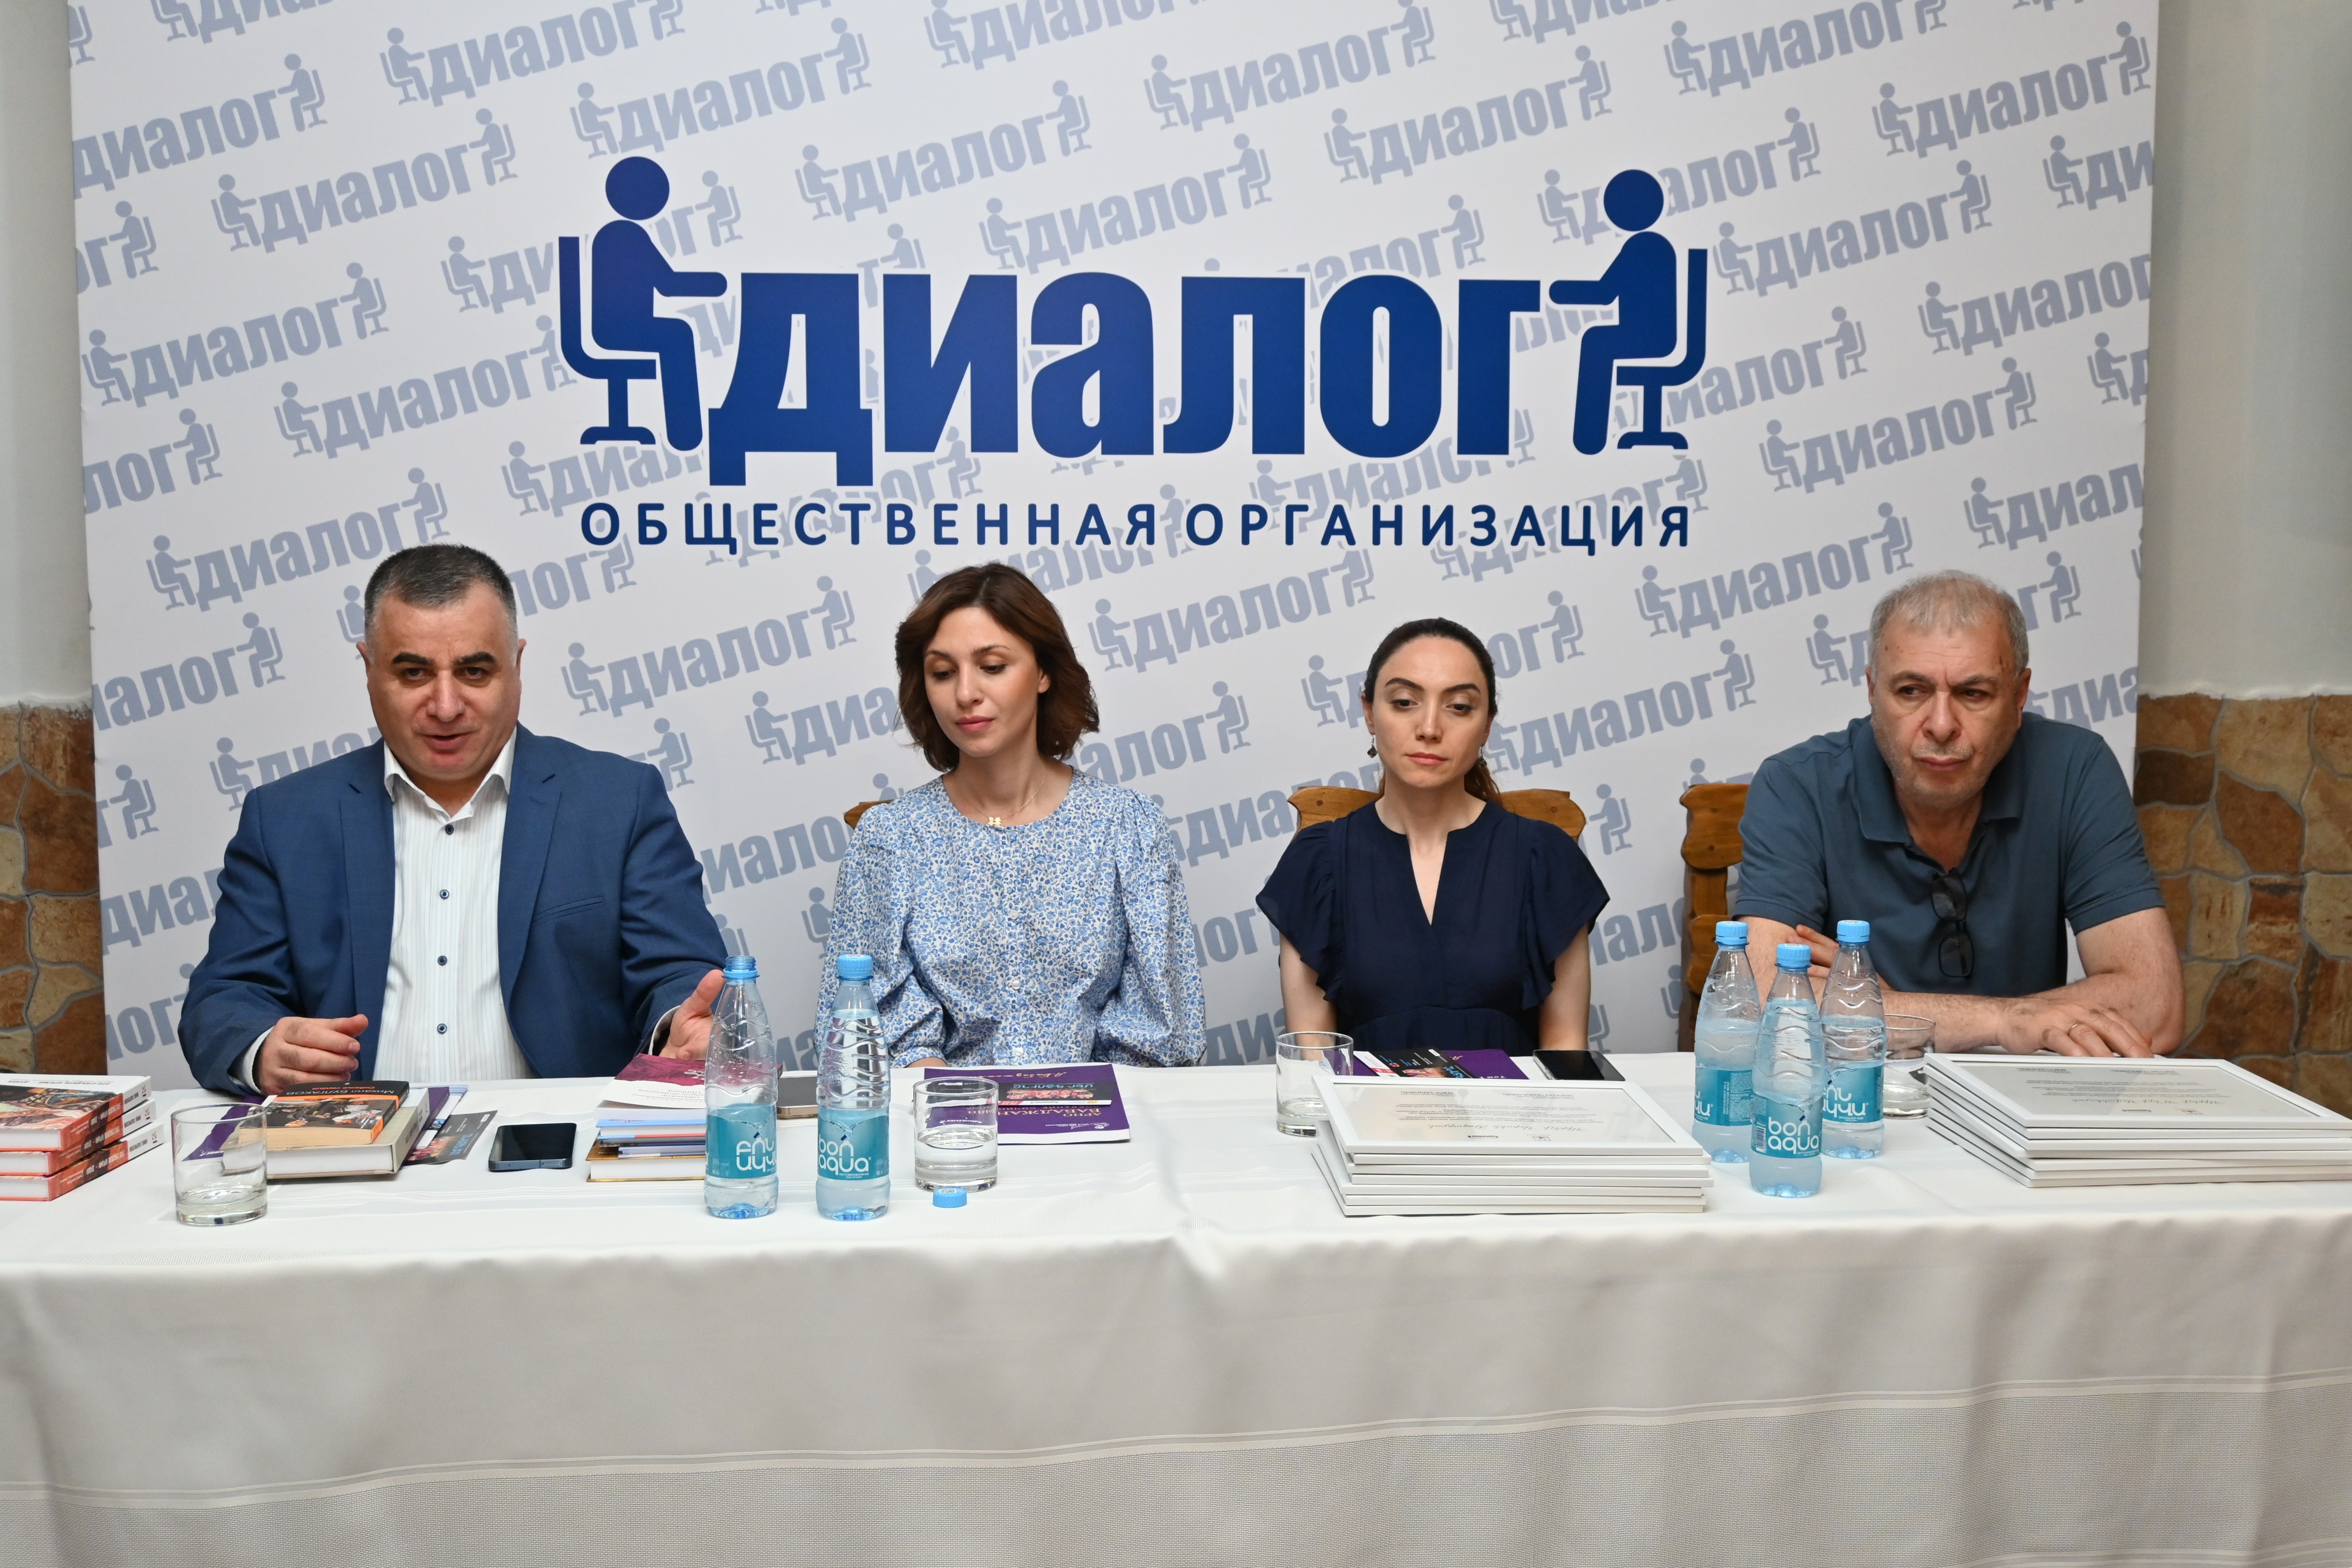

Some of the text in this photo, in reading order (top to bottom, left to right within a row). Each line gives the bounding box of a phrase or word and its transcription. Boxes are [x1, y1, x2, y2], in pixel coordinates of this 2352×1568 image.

[617, 53, 826, 153] диалог
[1189, 26, 1391, 133] диалог
[1915, 55, 2108, 159] диалог
[842, 115, 1046, 223] диалог
[1369, 80, 1568, 186] диалог
[259, 144, 471, 254] диалог
[1025, 168, 1227, 275] диалог
[1755, 193, 1949, 297] диалог
[130, 297, 343, 408] диалог
[321, 350, 531, 460] диалог
[709, 271, 1541, 486] диалог
[1802, 390, 1995, 494] диалог
[193, 502, 403, 612] диалог
[581, 502, 1689, 556] ОБЩЕСТВЕННАЯ ОРГАНИЗАЦИЯ
[1133, 567, 1332, 674] диалог
[1678, 535, 1871, 639] диалог
[607, 610, 812, 718] диалог
[1522, 673, 1714, 776] диалог
[818, 1156, 870, 1175] aqua
[819, 1138, 854, 1157] bon
[1768, 1116, 1810, 1136] bon
[1768, 1135, 1820, 1154] aqua
